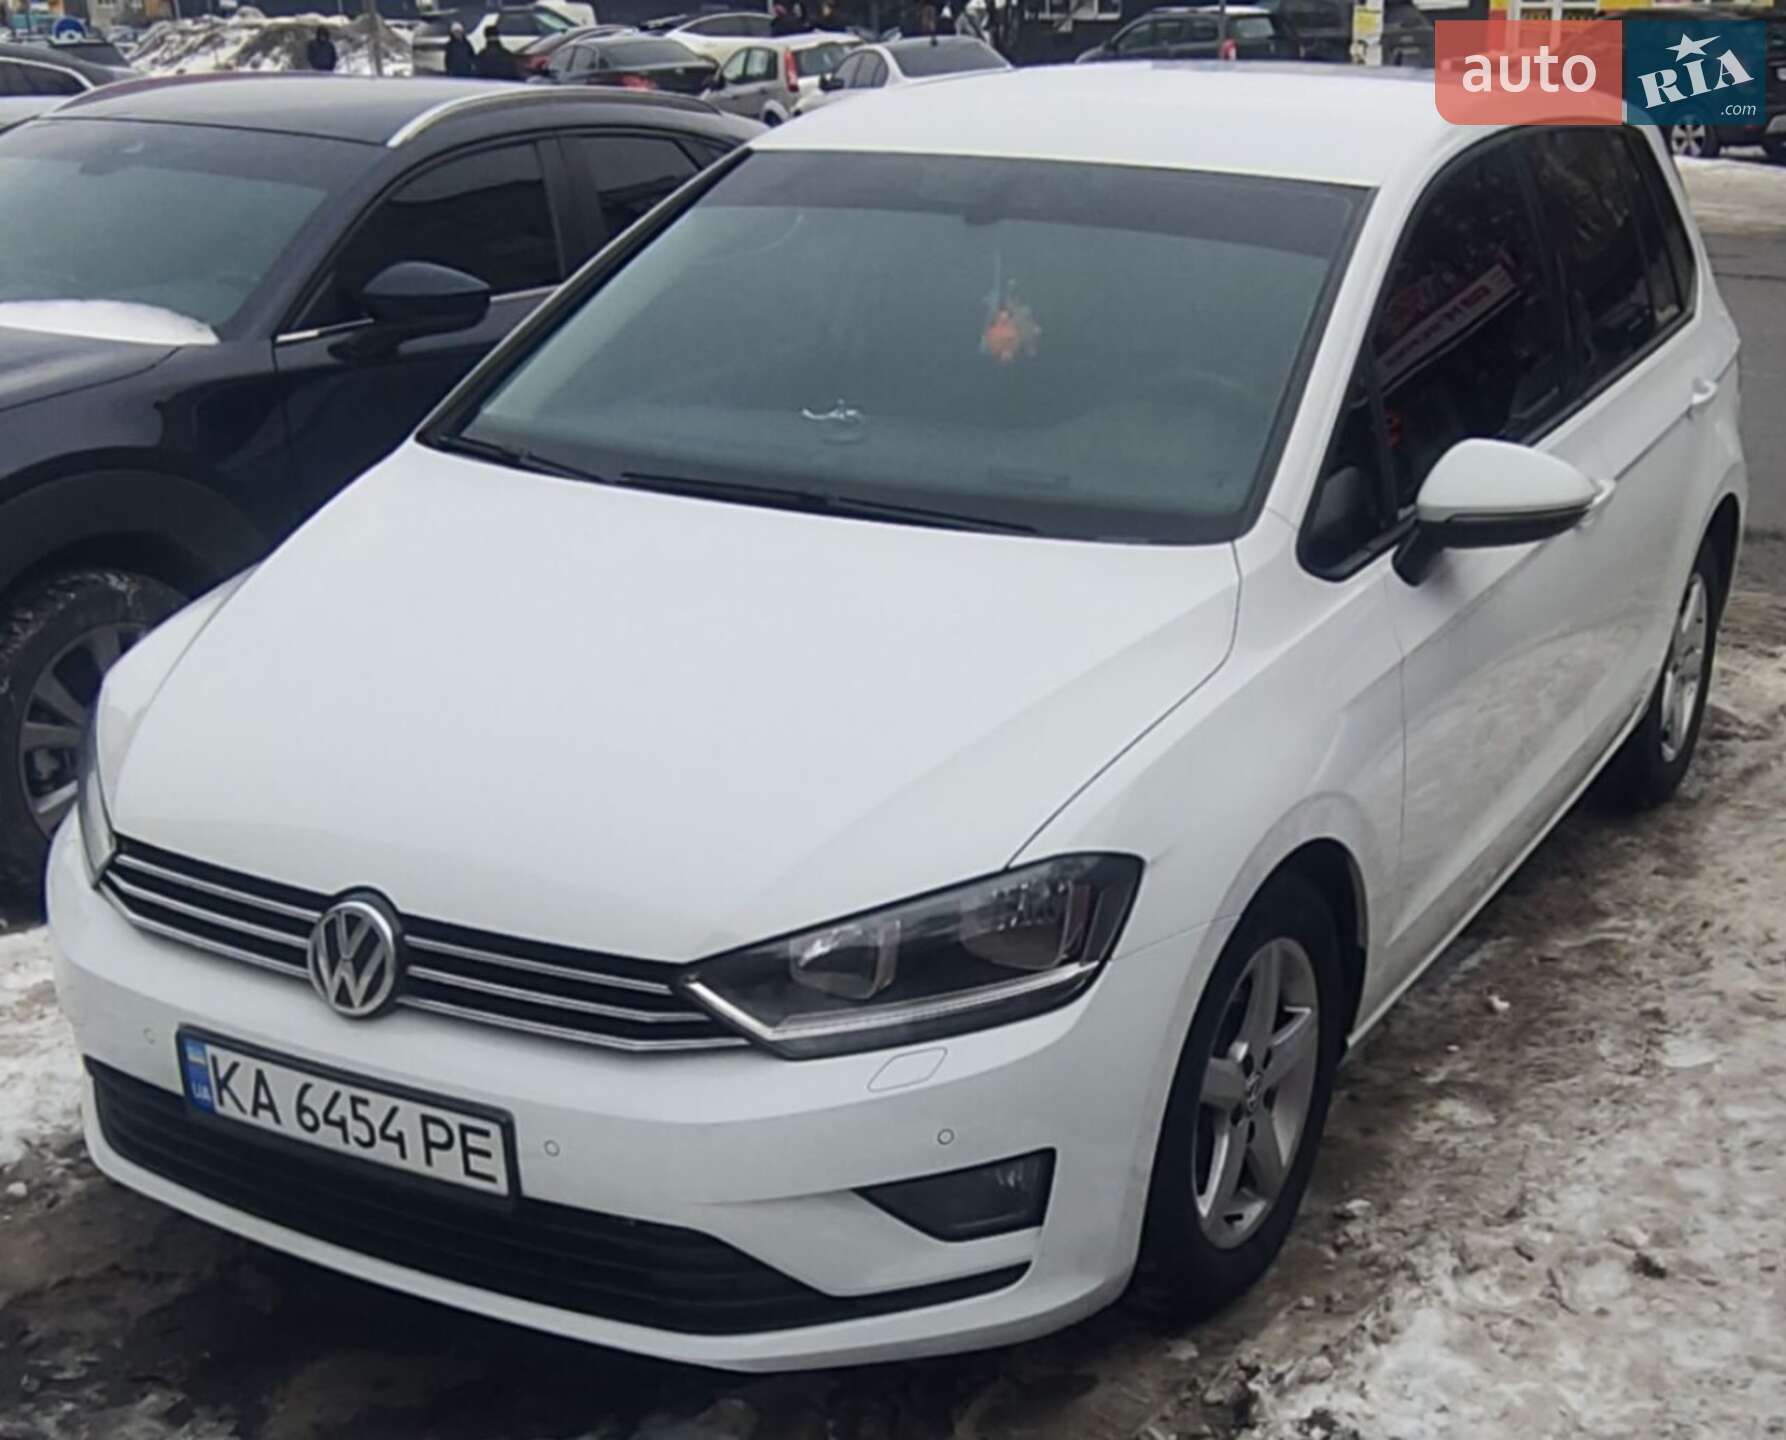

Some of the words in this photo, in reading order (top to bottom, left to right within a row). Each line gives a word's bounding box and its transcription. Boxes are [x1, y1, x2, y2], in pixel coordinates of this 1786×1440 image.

[211, 1054, 281, 1125] KA
[295, 1083, 407, 1160] 6454
[420, 1113, 497, 1184] PE
